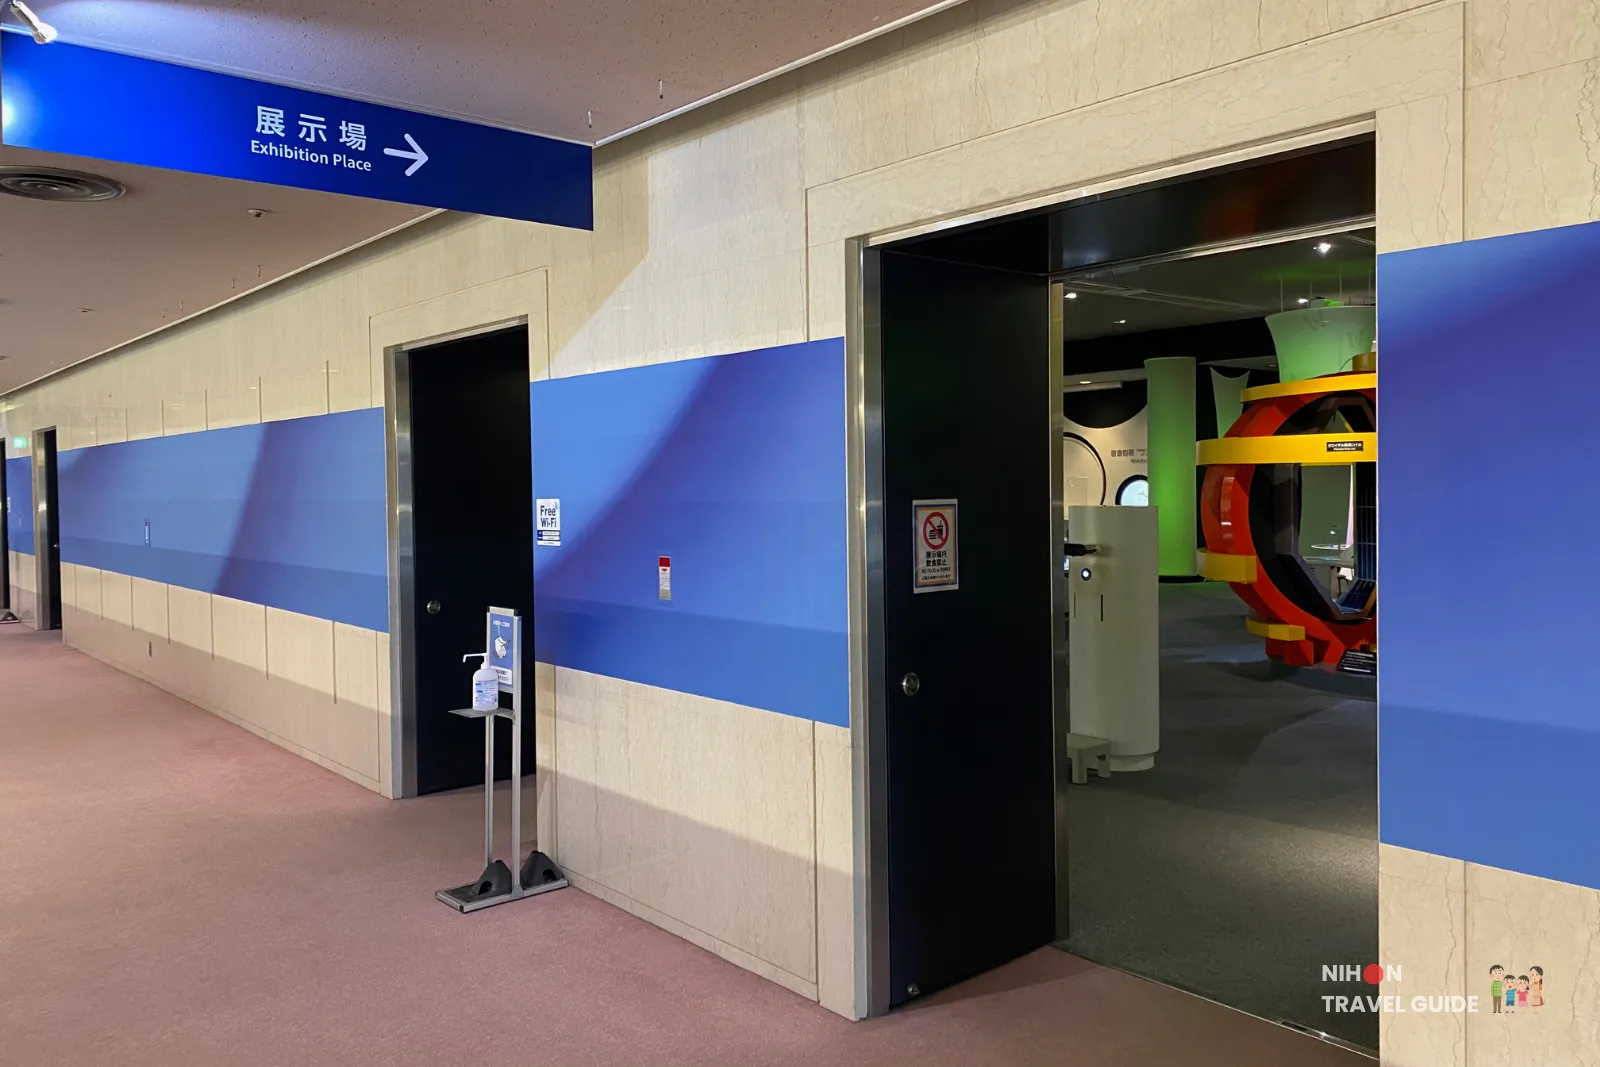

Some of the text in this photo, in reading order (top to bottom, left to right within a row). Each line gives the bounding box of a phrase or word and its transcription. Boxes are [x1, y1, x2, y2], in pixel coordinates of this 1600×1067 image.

[255, 105, 367, 151] 展示場
[250, 139, 372, 172] Exhibition Place
[540, 505, 556, 516] Free
[540, 517, 557, 528] Wi-Fi
[926, 550, 946, 558] 展示場内
